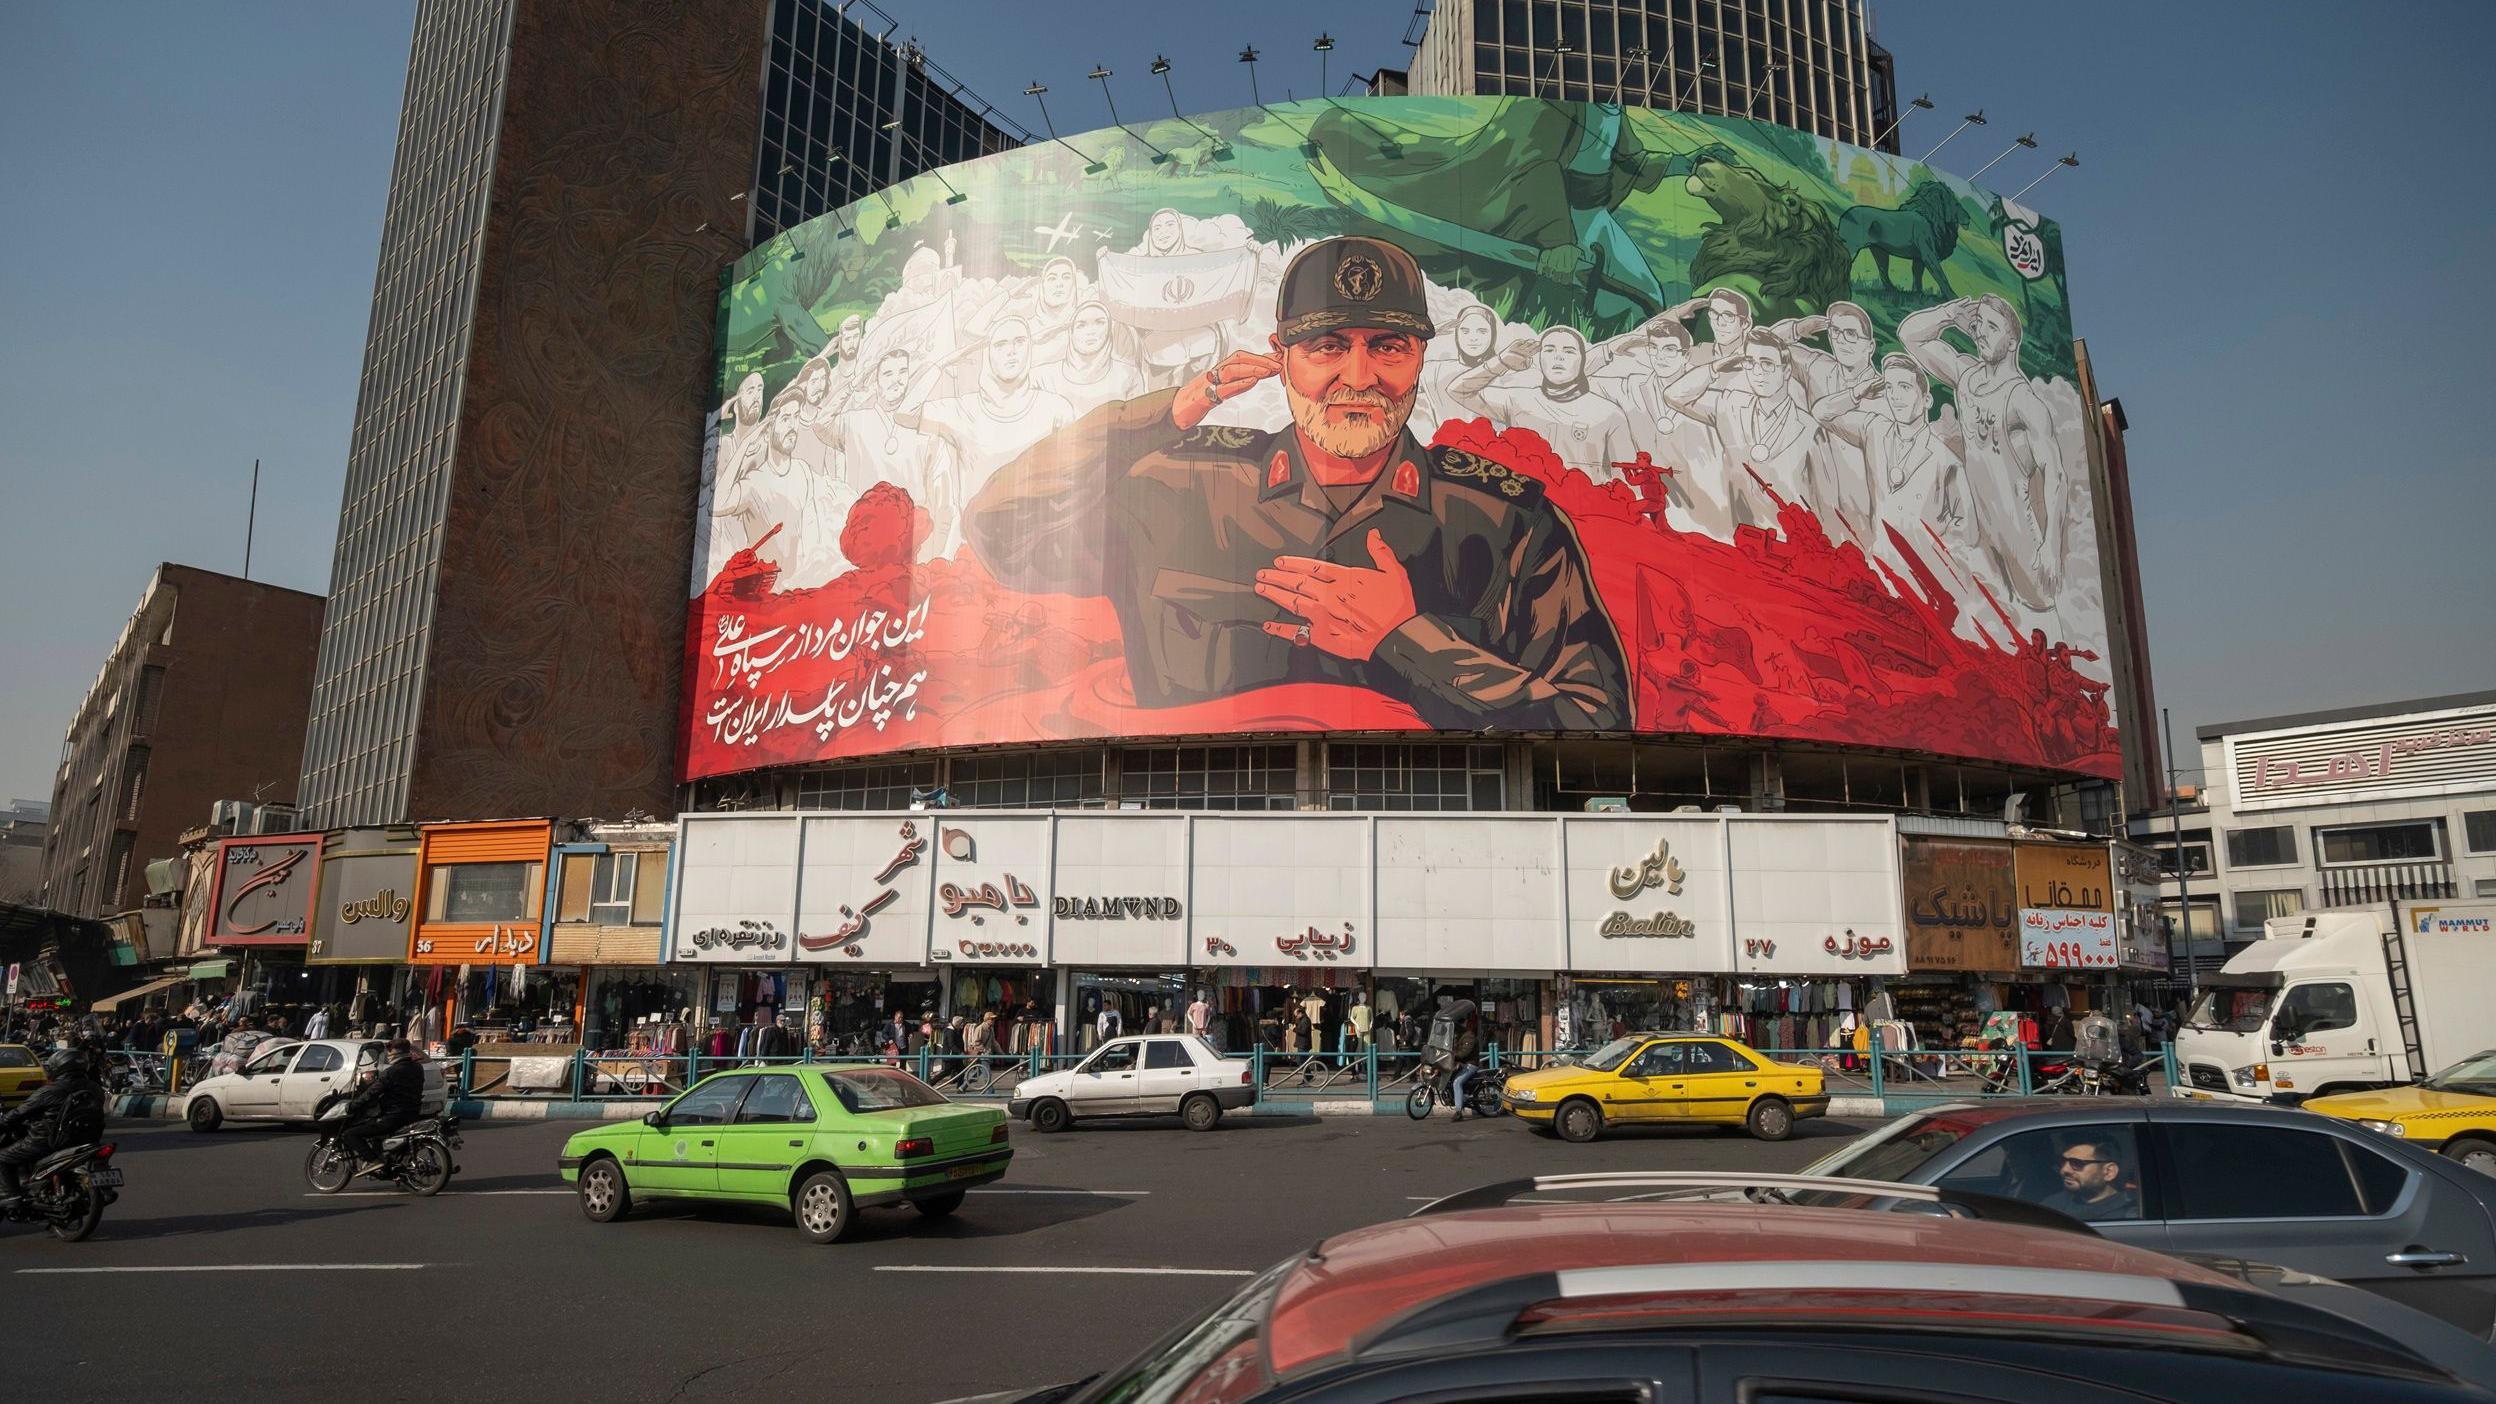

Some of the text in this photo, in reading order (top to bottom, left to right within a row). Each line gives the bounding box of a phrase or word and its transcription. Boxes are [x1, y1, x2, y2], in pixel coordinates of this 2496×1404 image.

[883, 593, 931, 648] این
[786, 622, 814, 663] از
[705, 696, 745, 744] است
[723, 692, 771, 746] ایران
[762, 678, 847, 742] پاسدار
[340, 888, 409, 924] والس
[2025, 912, 2108, 931] کلیه اجناس زنانه
[1275, 921, 1352, 957] زیبایی
[1600, 910, 1694, 938] Balin
[416, 940, 432, 953] 36
[1205, 935, 1233, 953] ۳۰
[1745, 937, 1773, 956] ۲۷
[1823, 928, 1891, 955] موزه
[2045, 941, 2116, 969] ۵۹۹۰۰۰
